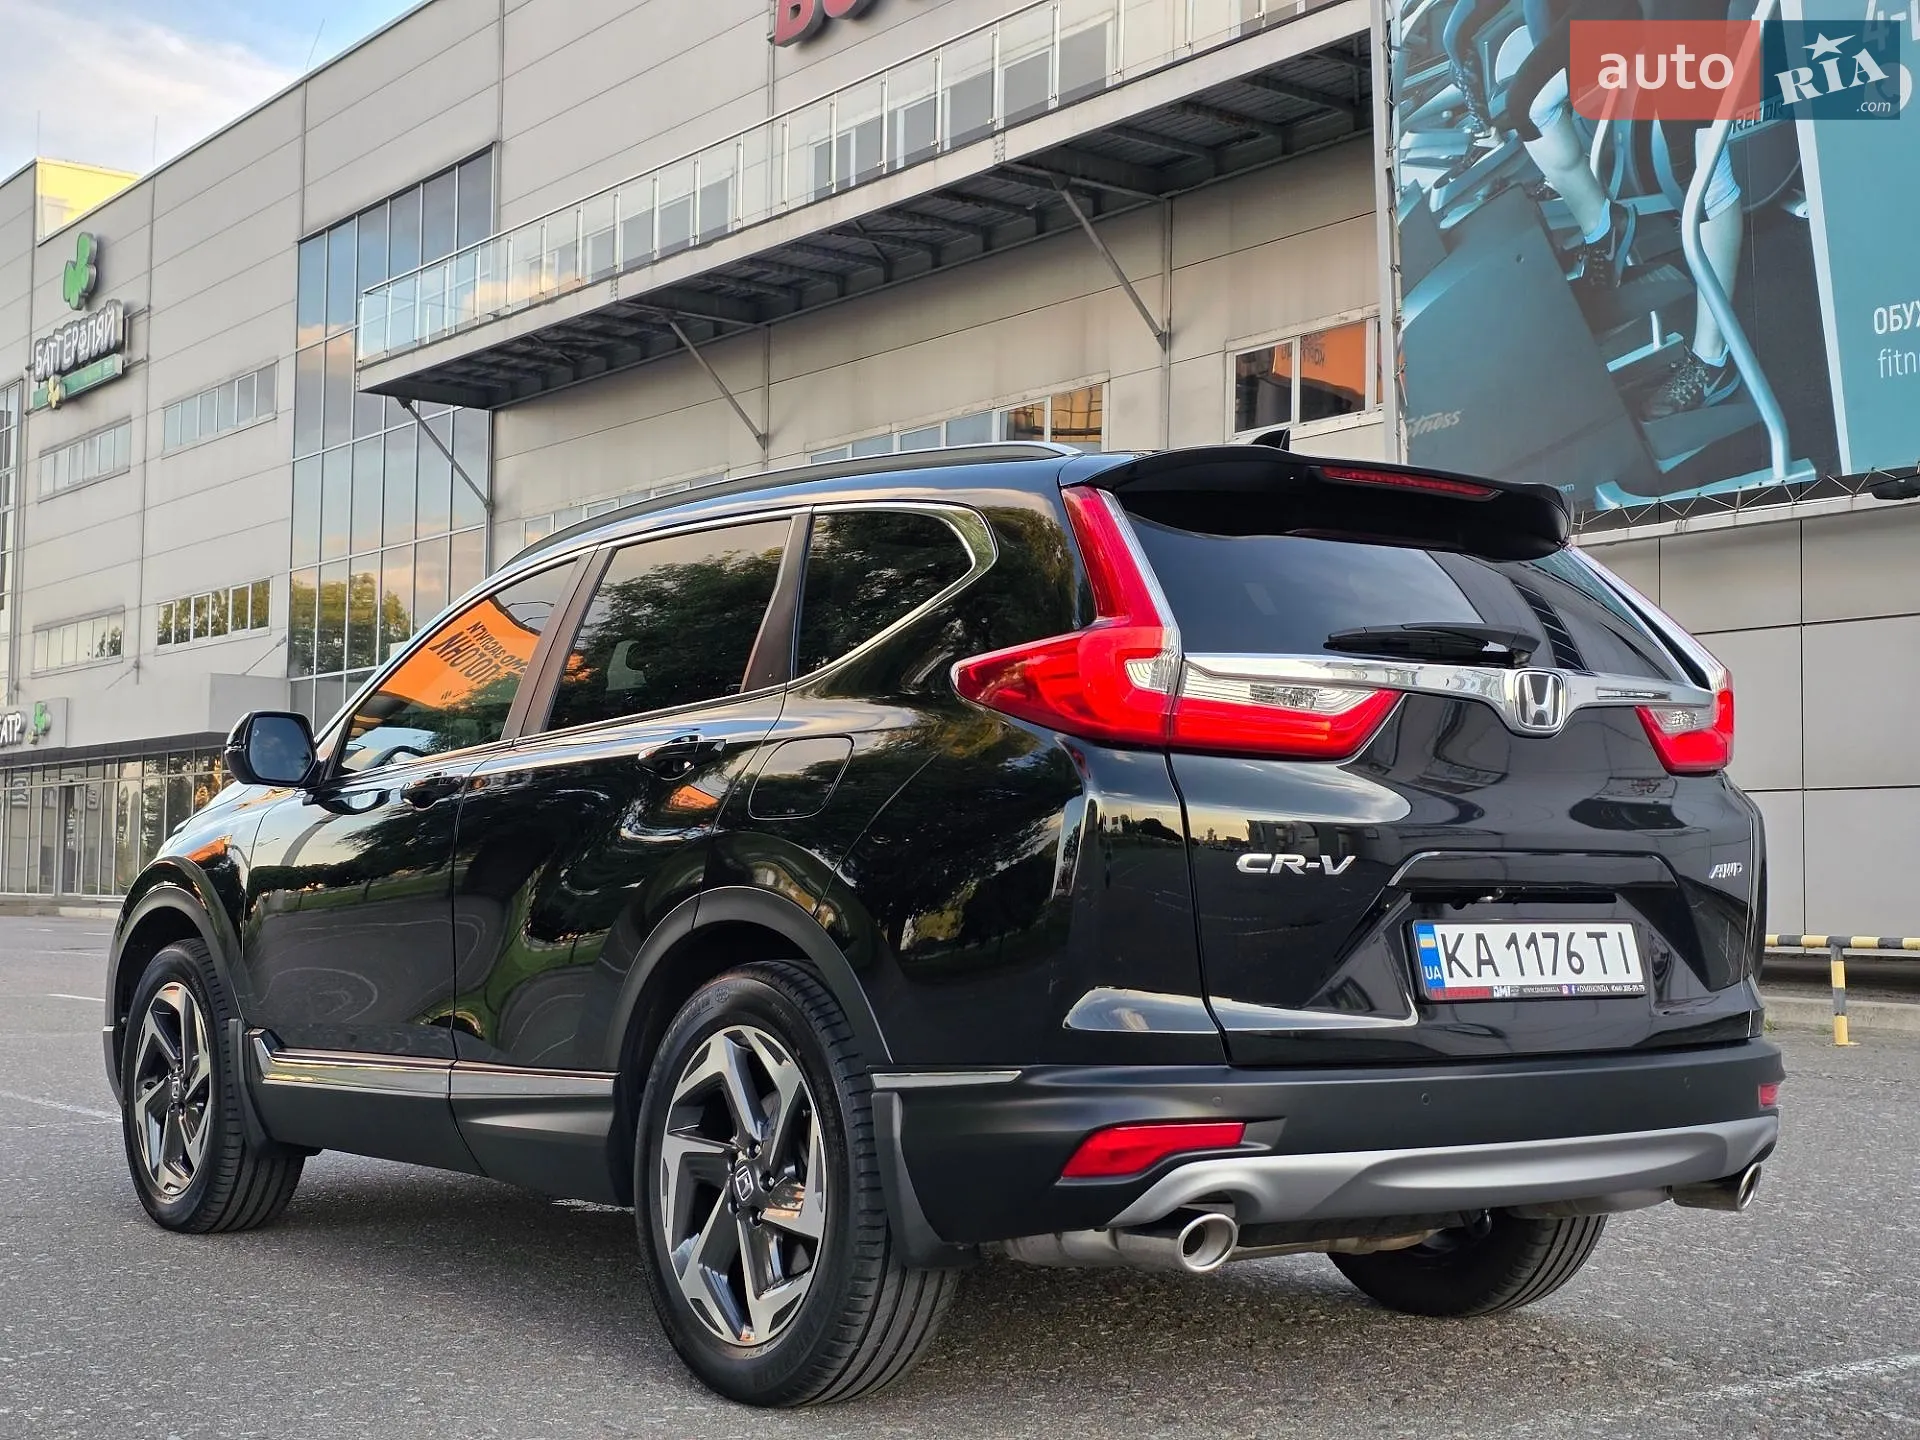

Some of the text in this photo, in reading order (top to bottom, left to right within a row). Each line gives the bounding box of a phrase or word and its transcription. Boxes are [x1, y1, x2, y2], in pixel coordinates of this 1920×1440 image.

[1877, 348, 1920, 379] fitn
[1236, 853, 1356, 875] CR-V
[1424, 965, 1442, 981] UA
